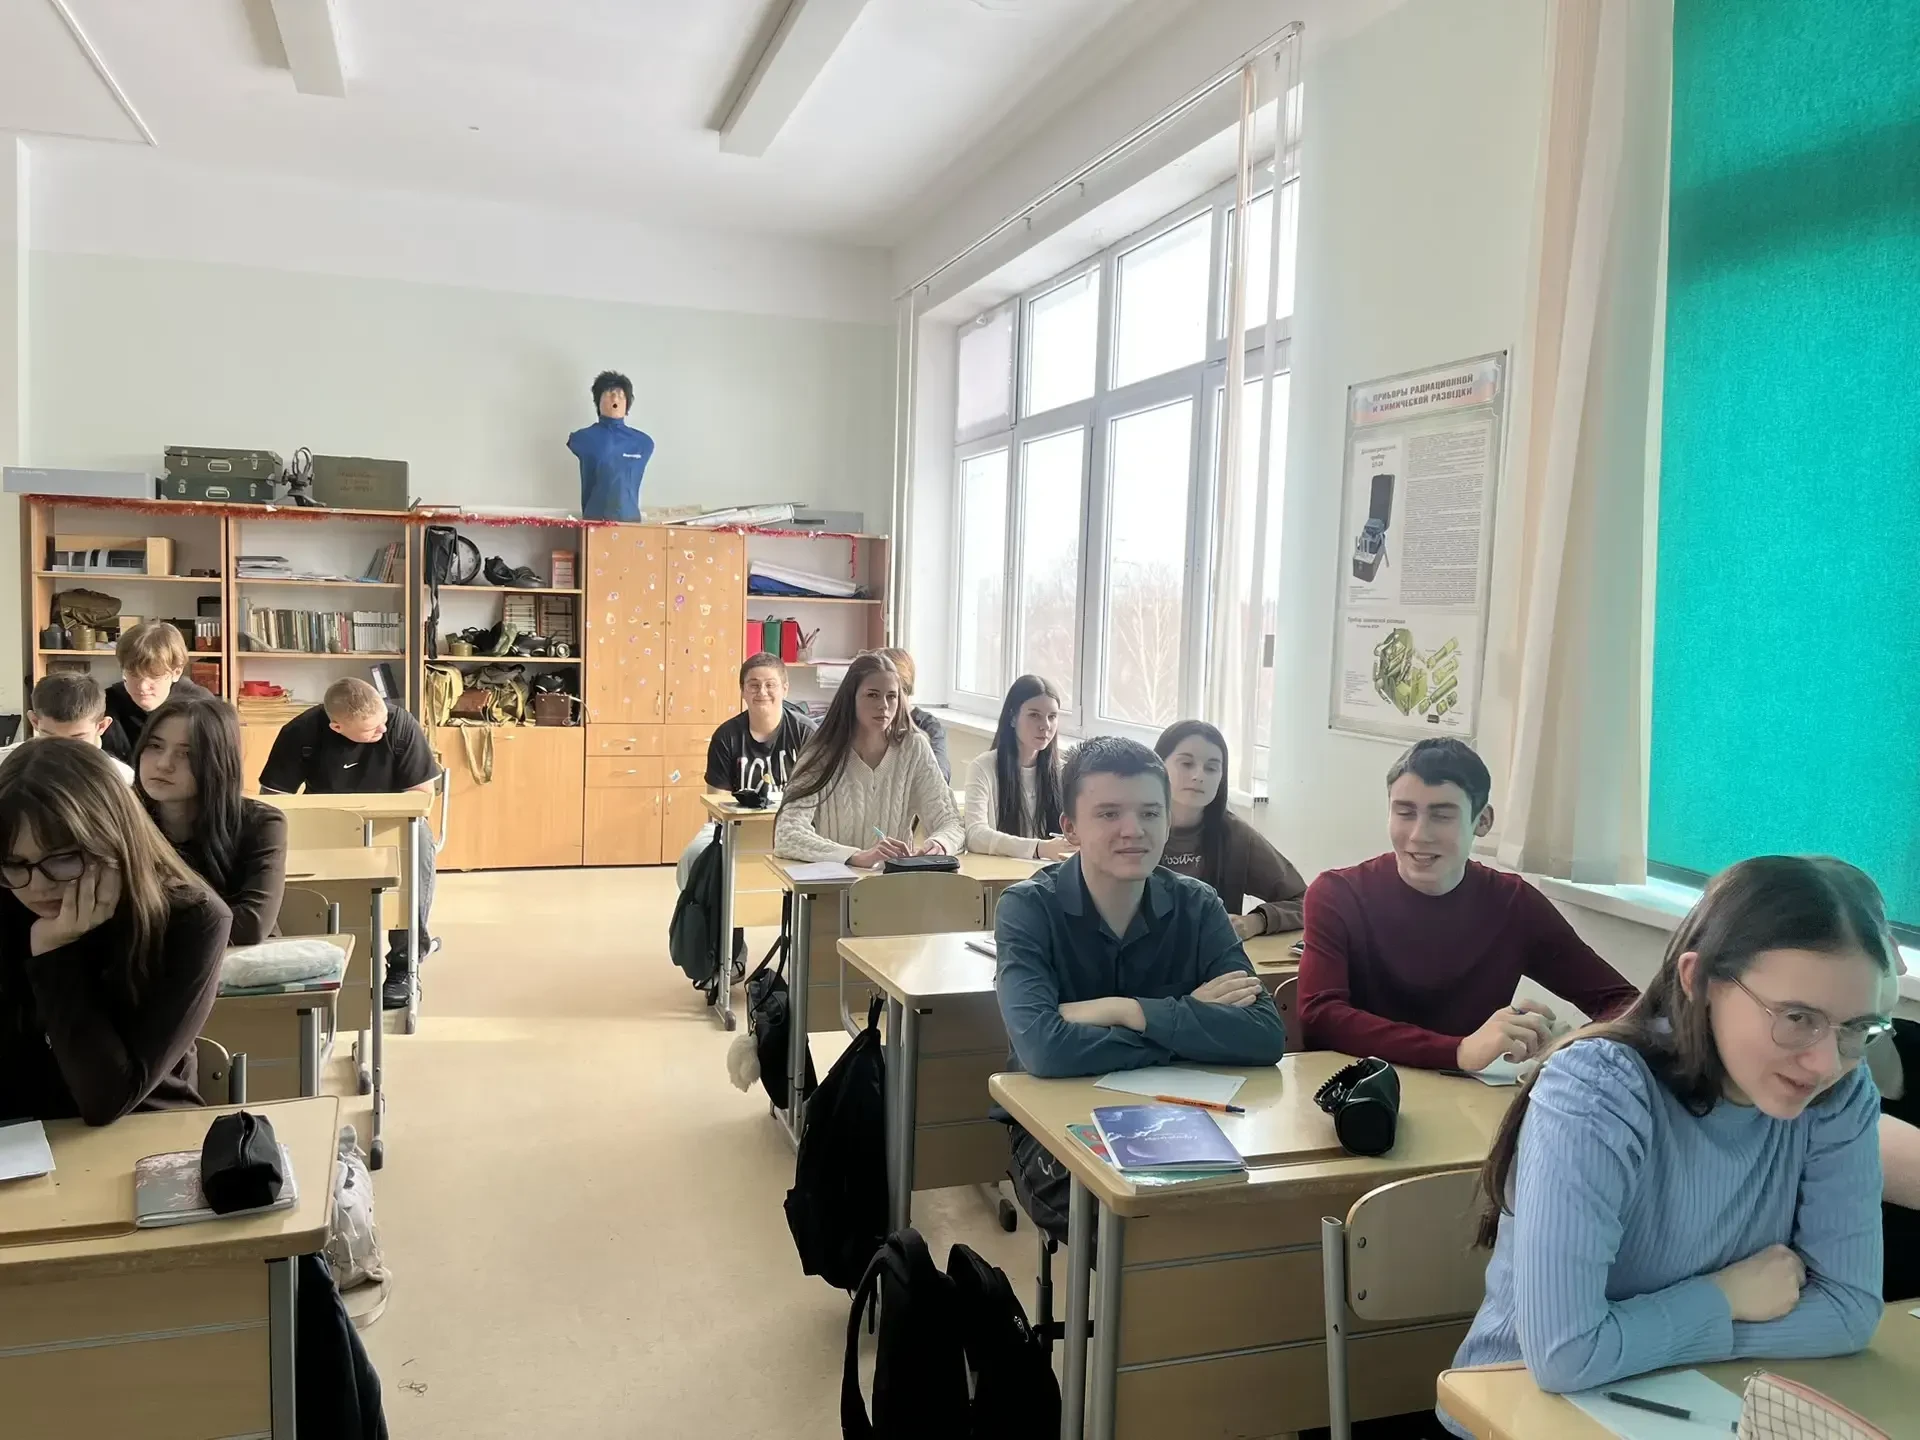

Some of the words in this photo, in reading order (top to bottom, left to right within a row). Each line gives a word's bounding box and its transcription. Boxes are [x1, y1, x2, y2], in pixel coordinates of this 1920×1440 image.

[1373, 387, 1408, 402] ПРИБОРЫ
[1410, 373, 1473, 395] РАДИАЦИОННОЙ
[1373, 405, 1378, 413] И
[1380, 394, 1429, 412] ХИМИЧЕСКОЙ
[1431, 387, 1473, 402] РАЗВЕДКИ
